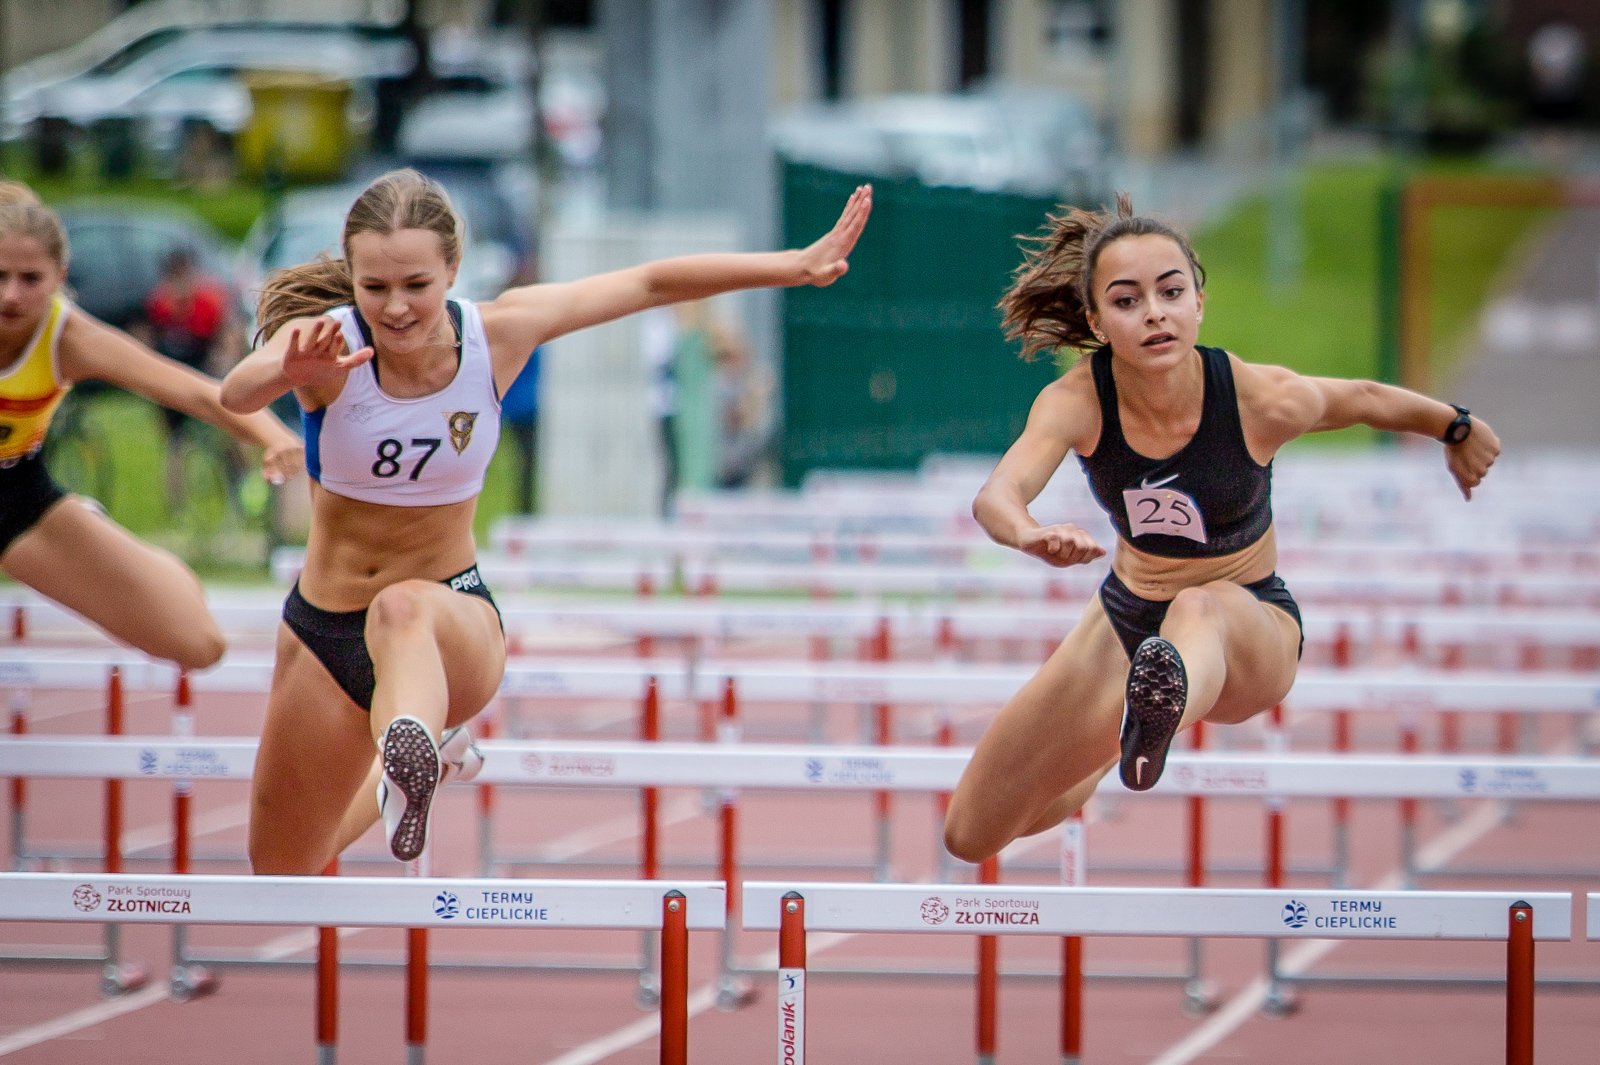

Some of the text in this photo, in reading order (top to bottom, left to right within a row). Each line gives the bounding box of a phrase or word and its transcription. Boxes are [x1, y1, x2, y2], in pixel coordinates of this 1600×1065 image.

[371, 438, 442, 481] 87
[1136, 497, 1192, 526] 25
[450, 569, 480, 592] PRO
[107, 885, 191, 899] Park Sportowy
[482, 892, 533, 904] TERMY
[107, 899, 191, 914] ZŁOTNICZA
[955, 898, 1039, 910] Park Sportowy
[1330, 900, 1382, 912] TERMY
[466, 907, 548, 920] CIEPLICKIE
[955, 911, 1040, 925] ZŁOTNICZA
[1315, 916, 1397, 929] CIEPLICKIE
